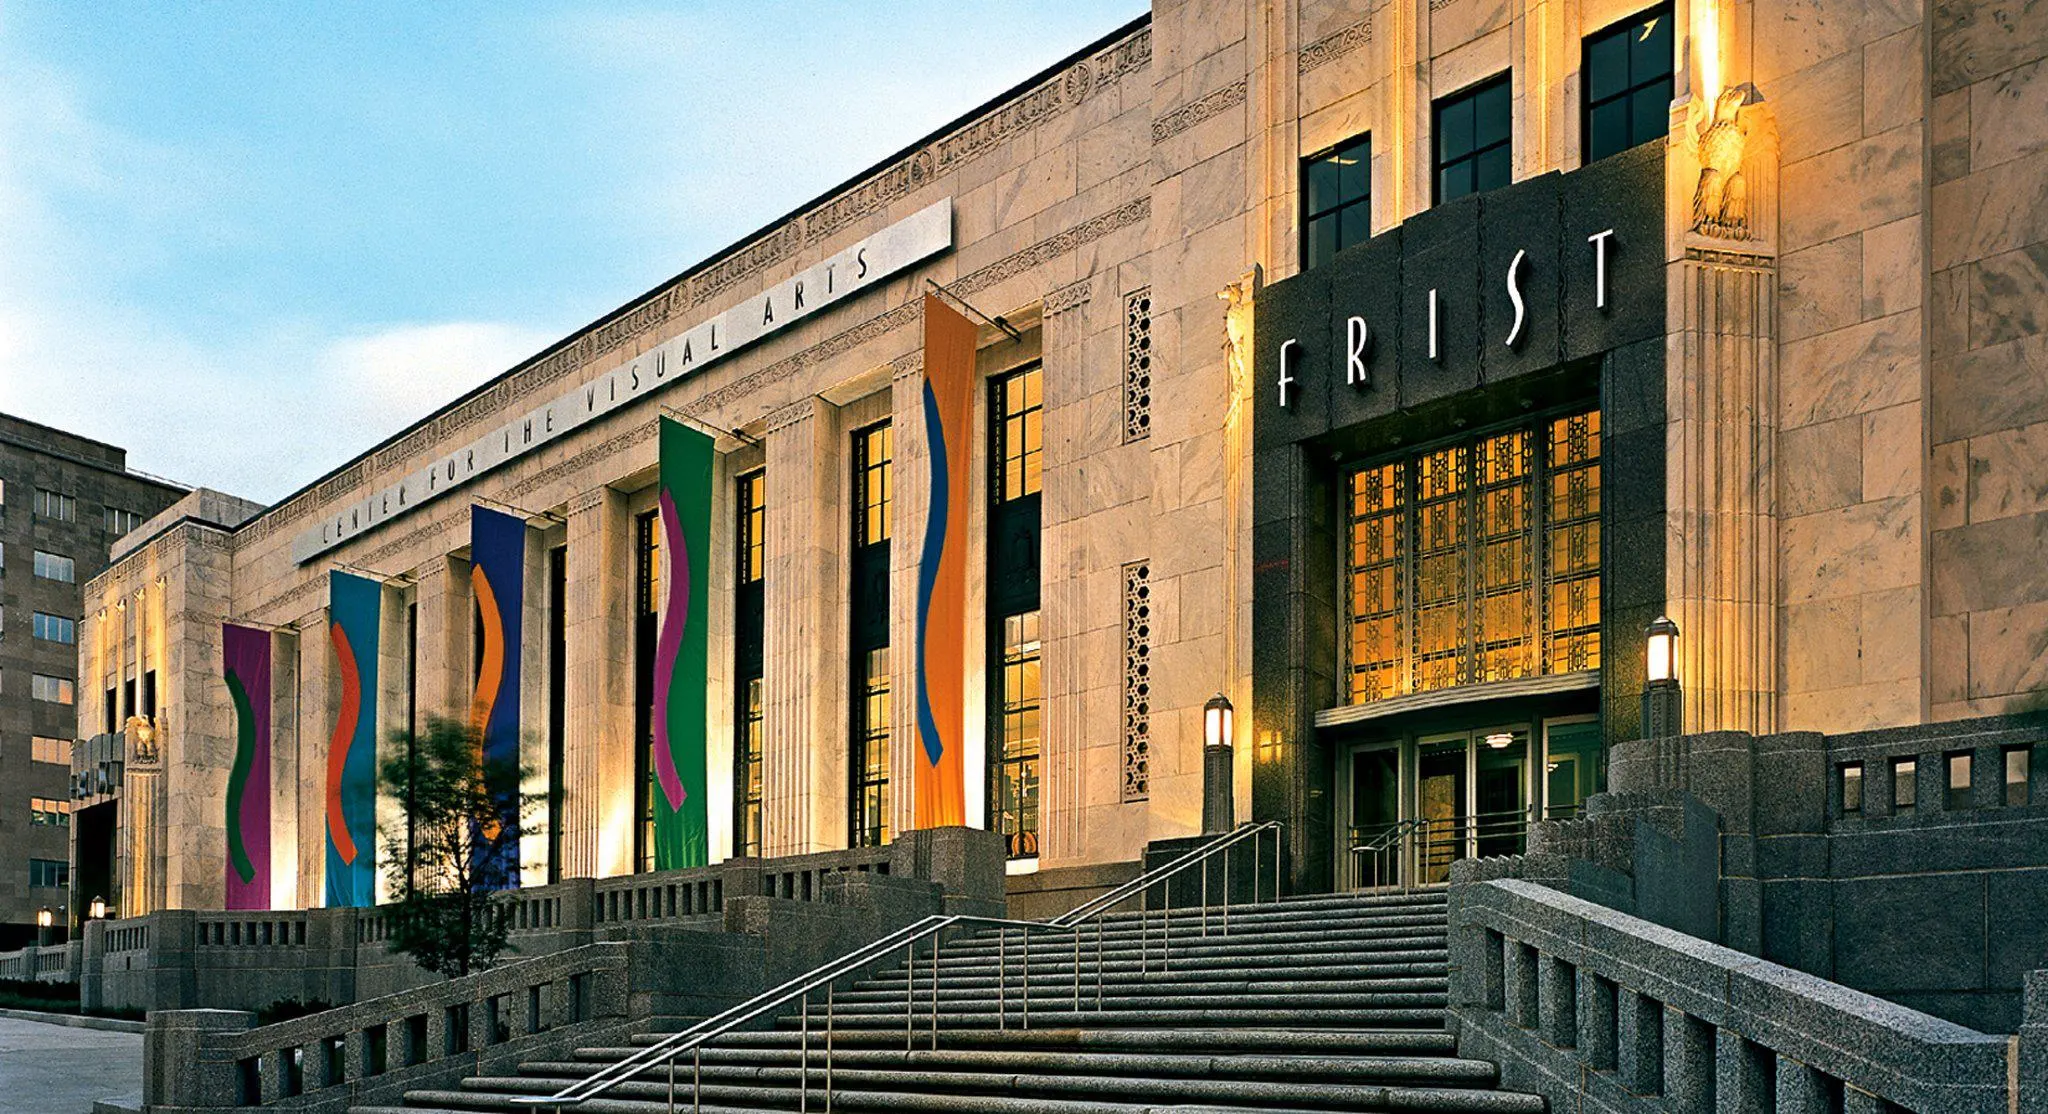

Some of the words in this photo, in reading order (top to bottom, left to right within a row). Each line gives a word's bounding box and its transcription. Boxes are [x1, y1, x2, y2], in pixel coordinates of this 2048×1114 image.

[322, 485, 406, 544] CENTER
[430, 449, 474, 490] FOR
[504, 408, 553, 453] THE
[586, 324, 719, 412] VISUAL
[763, 247, 867, 326] ARTS
[1278, 229, 1613, 407] FRIST
